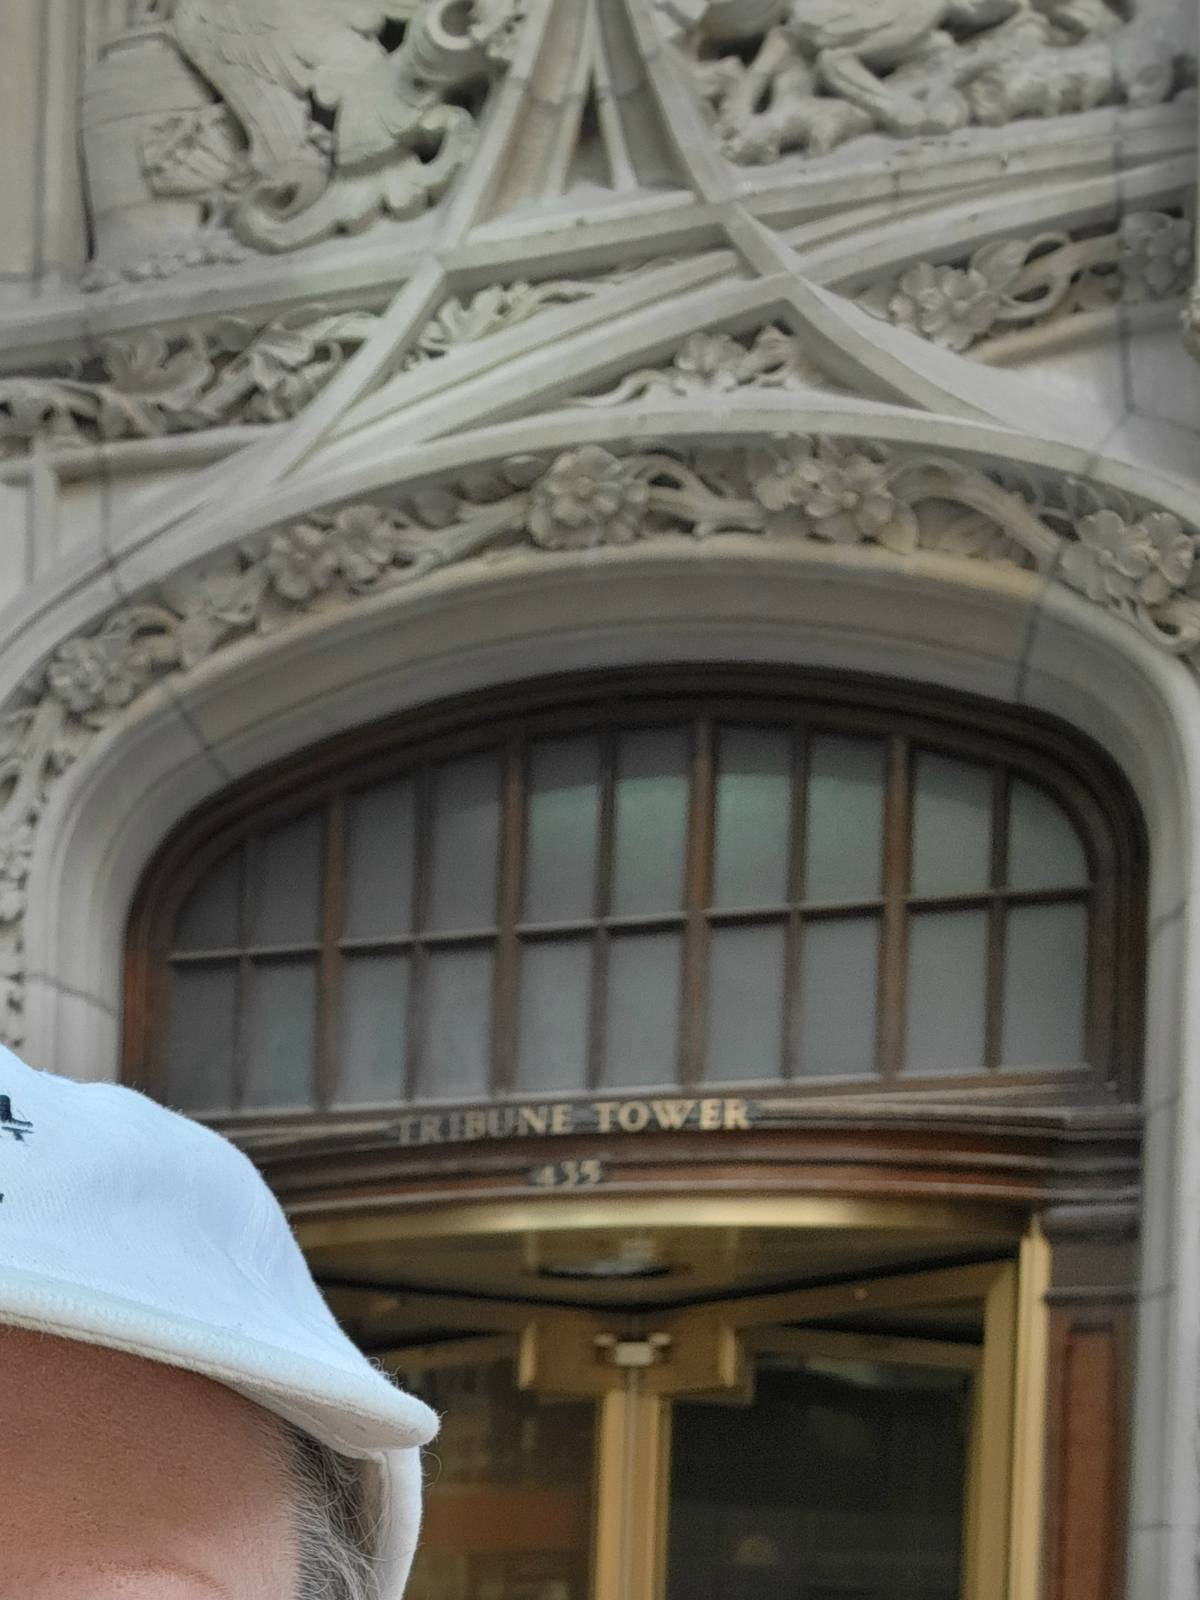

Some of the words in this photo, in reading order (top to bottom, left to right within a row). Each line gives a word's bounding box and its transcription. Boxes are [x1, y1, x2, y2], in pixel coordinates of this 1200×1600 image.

[399, 1104, 573, 1145] TRIBUNE
[594, 1099, 750, 1132] TOWER
[536, 1160, 601, 1186] 435
